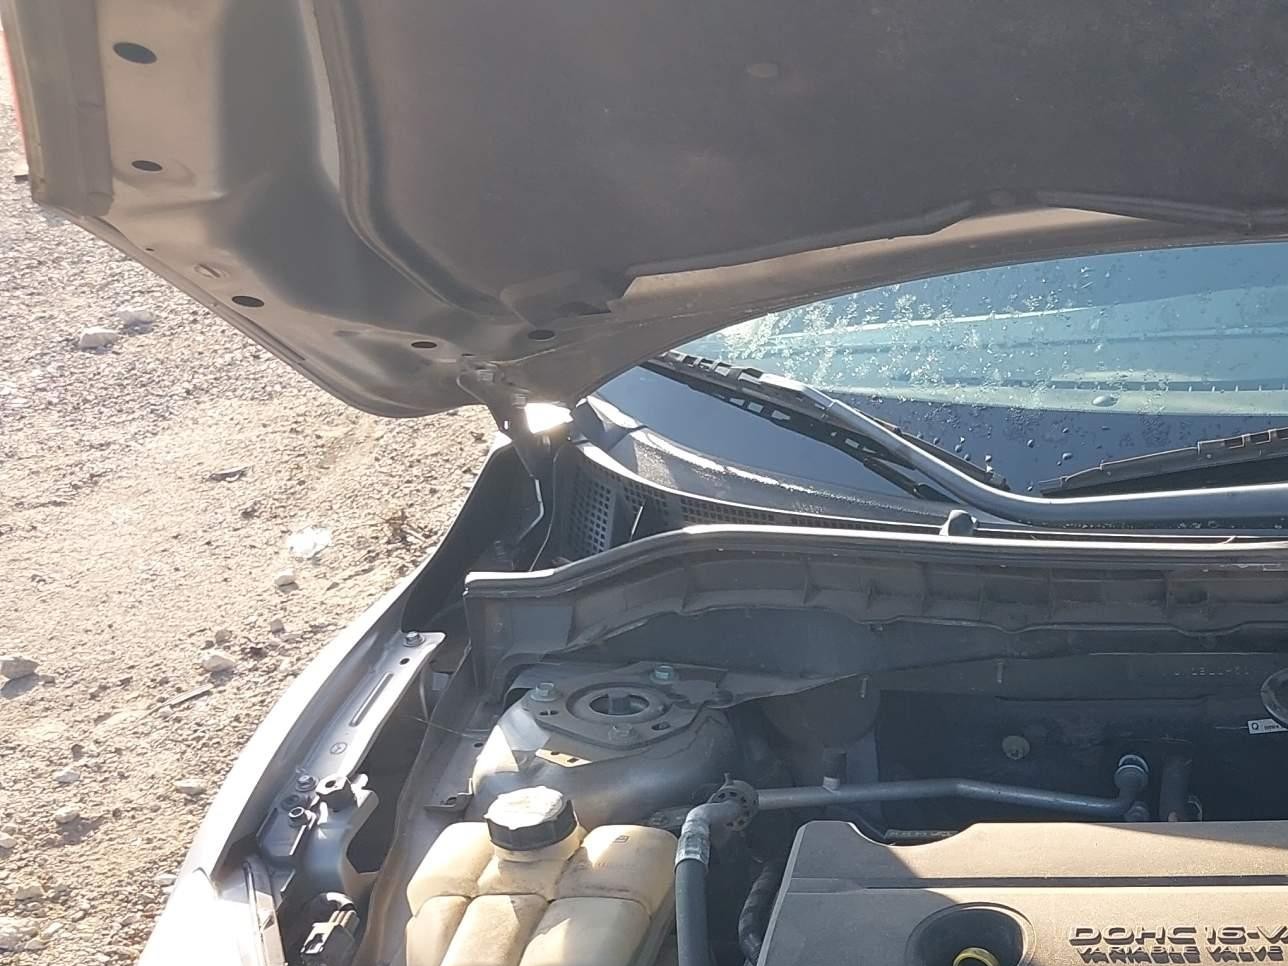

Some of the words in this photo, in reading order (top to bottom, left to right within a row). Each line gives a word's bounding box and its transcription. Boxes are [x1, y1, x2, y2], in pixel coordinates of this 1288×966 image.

[1069, 926, 1197, 946] DOHC
[1078, 945, 1202, 964] VARIABLE
[1205, 944, 1284, 962] VALVE
